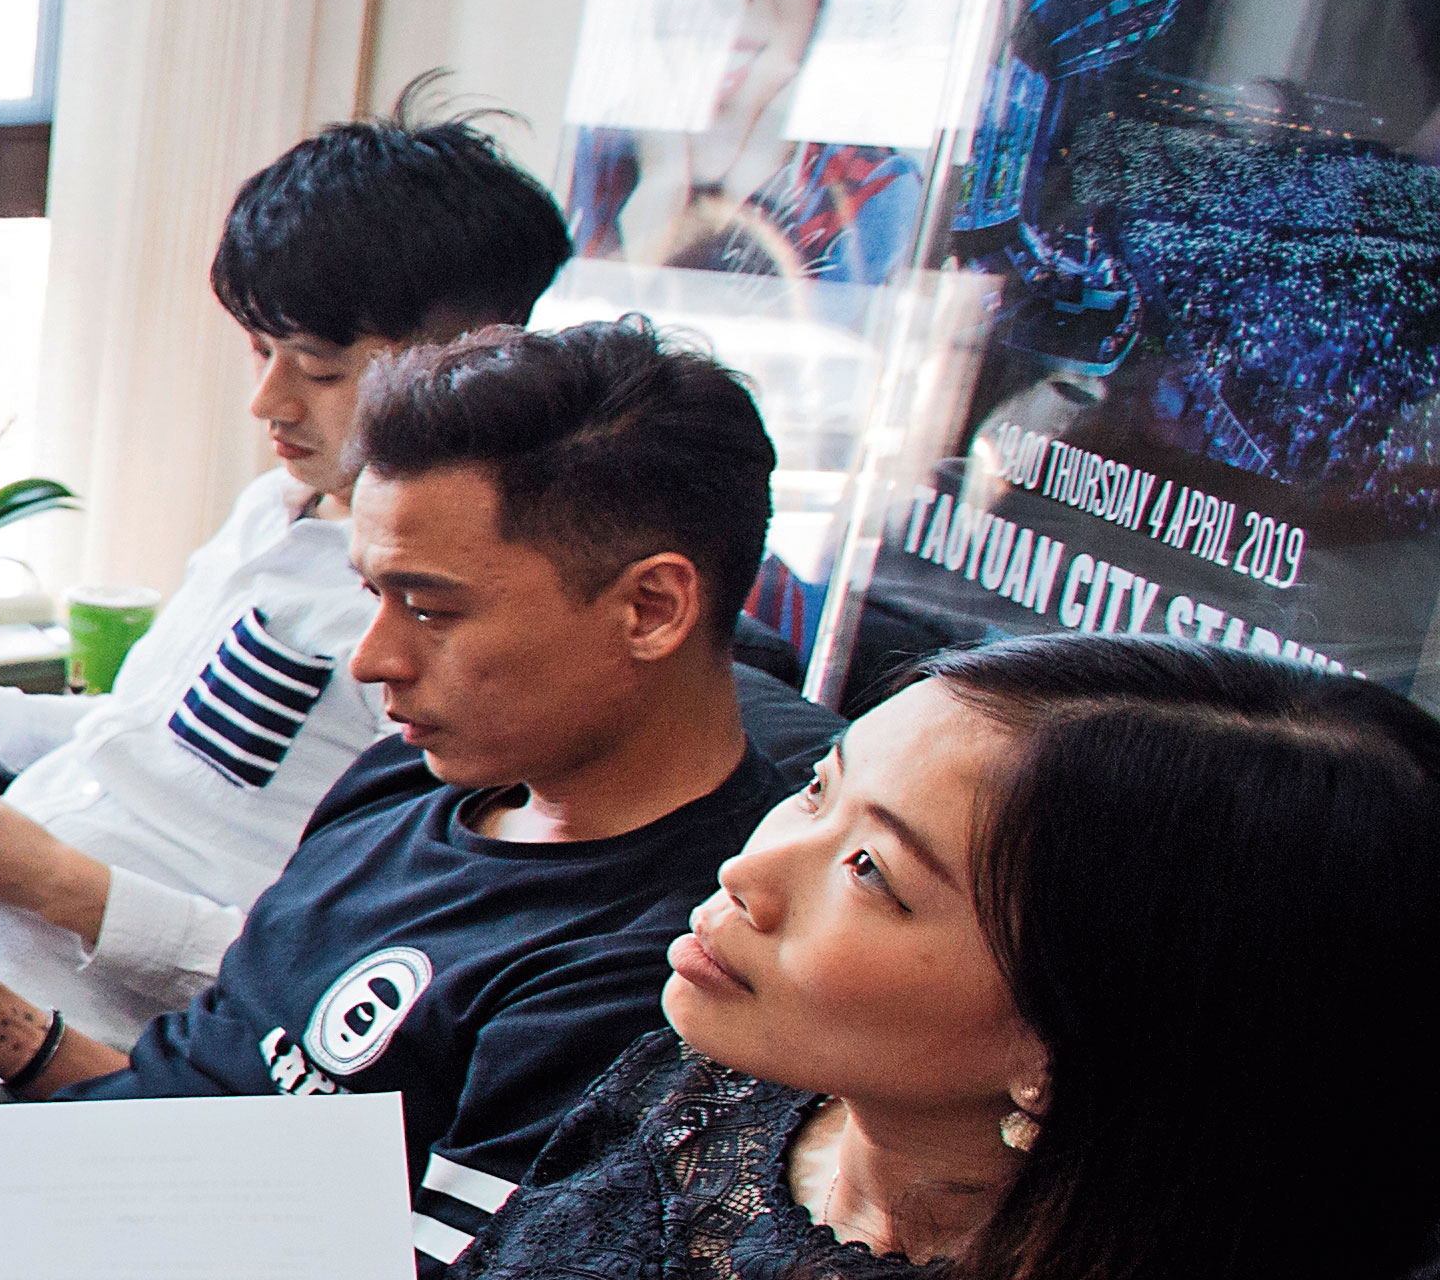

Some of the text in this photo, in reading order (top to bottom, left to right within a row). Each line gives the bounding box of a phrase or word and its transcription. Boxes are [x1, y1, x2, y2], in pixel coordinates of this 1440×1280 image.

[904, 485, 1065, 615] TAOYUAN
[1058, 553, 1161, 635] CITY
[1042, 439, 1157, 532] THURSDAY
[1148, 480, 1173, 539] 4
[1162, 486, 1238, 567] APRIL
[1233, 511, 1306, 589] 2019
